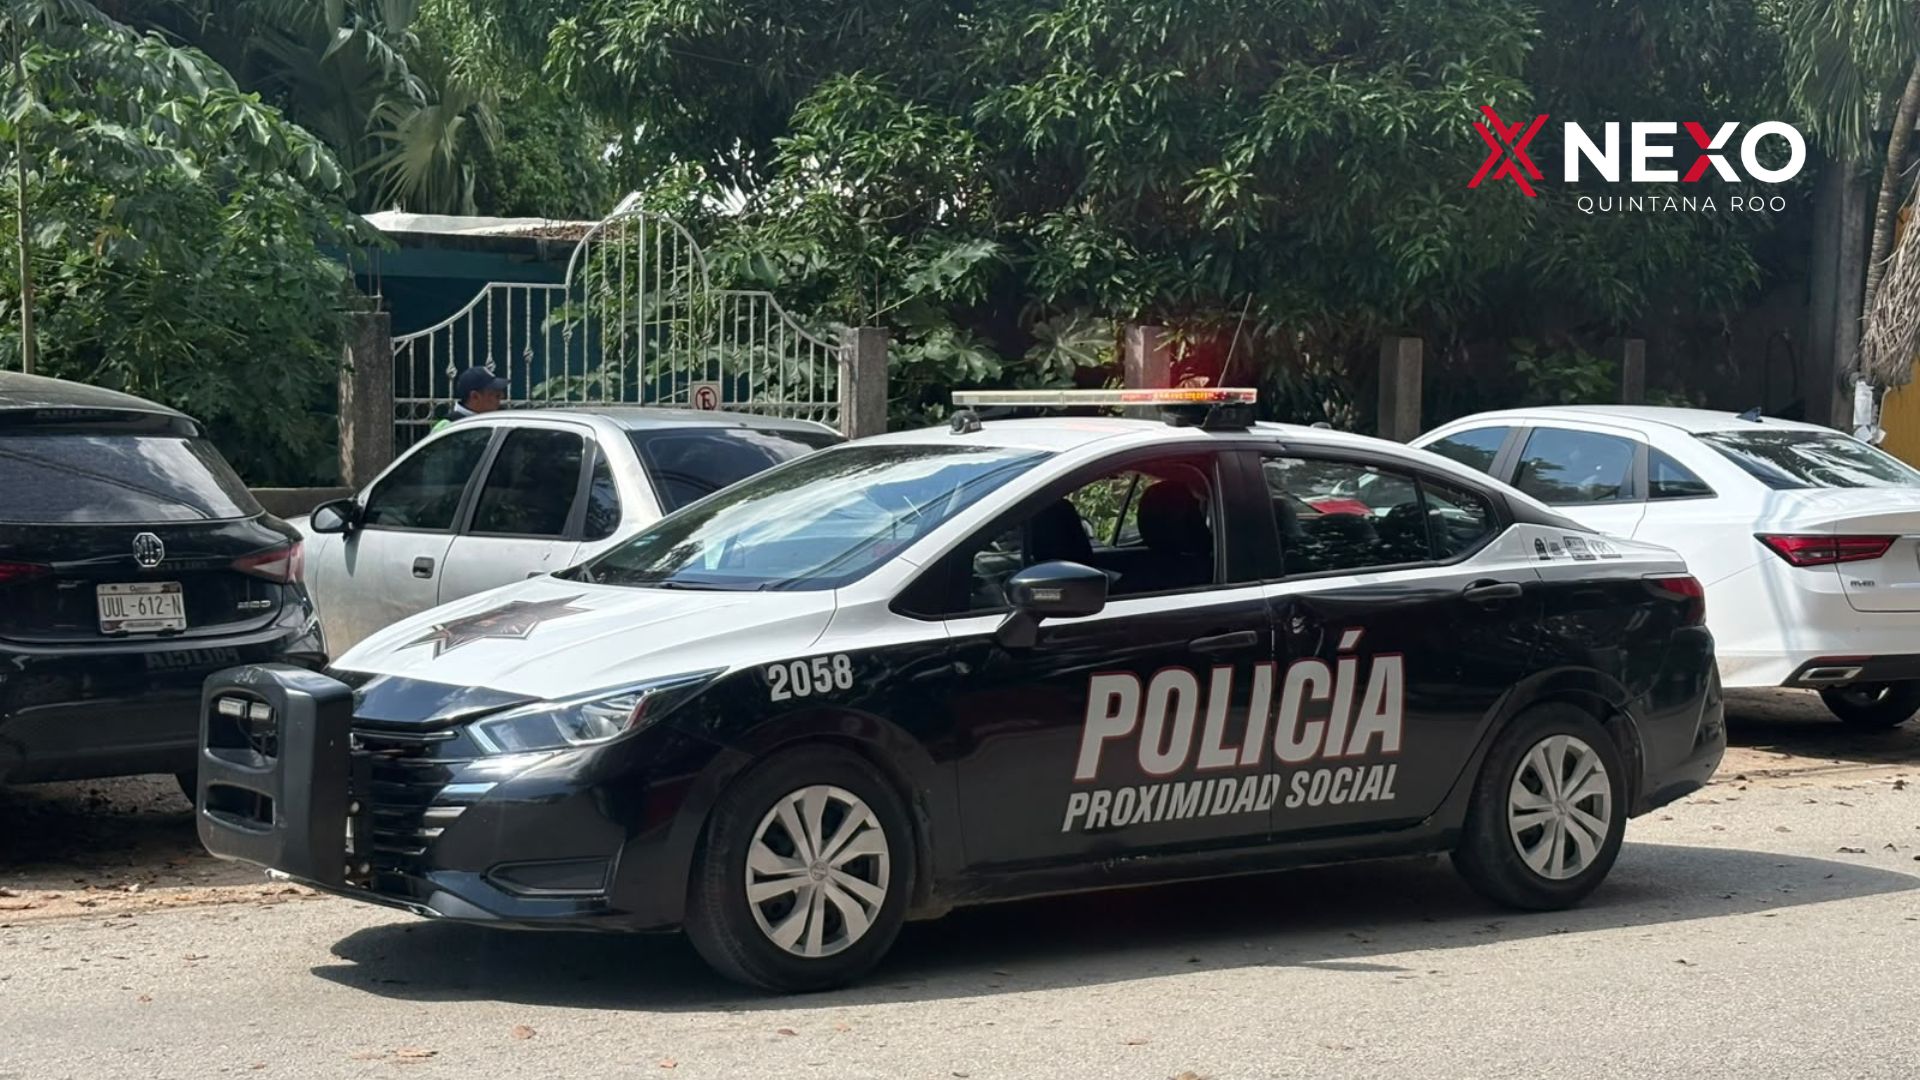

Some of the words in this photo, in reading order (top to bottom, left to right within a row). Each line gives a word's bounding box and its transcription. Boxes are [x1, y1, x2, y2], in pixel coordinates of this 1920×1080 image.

[102, 594, 182, 618] UUL-612-N
[767, 653, 854, 702] 2058
[1073, 627, 1405, 784] POLICÍA
[1061, 773, 1282, 832] PROXIMIDAD
[1285, 764, 1398, 808] SOCIAL
